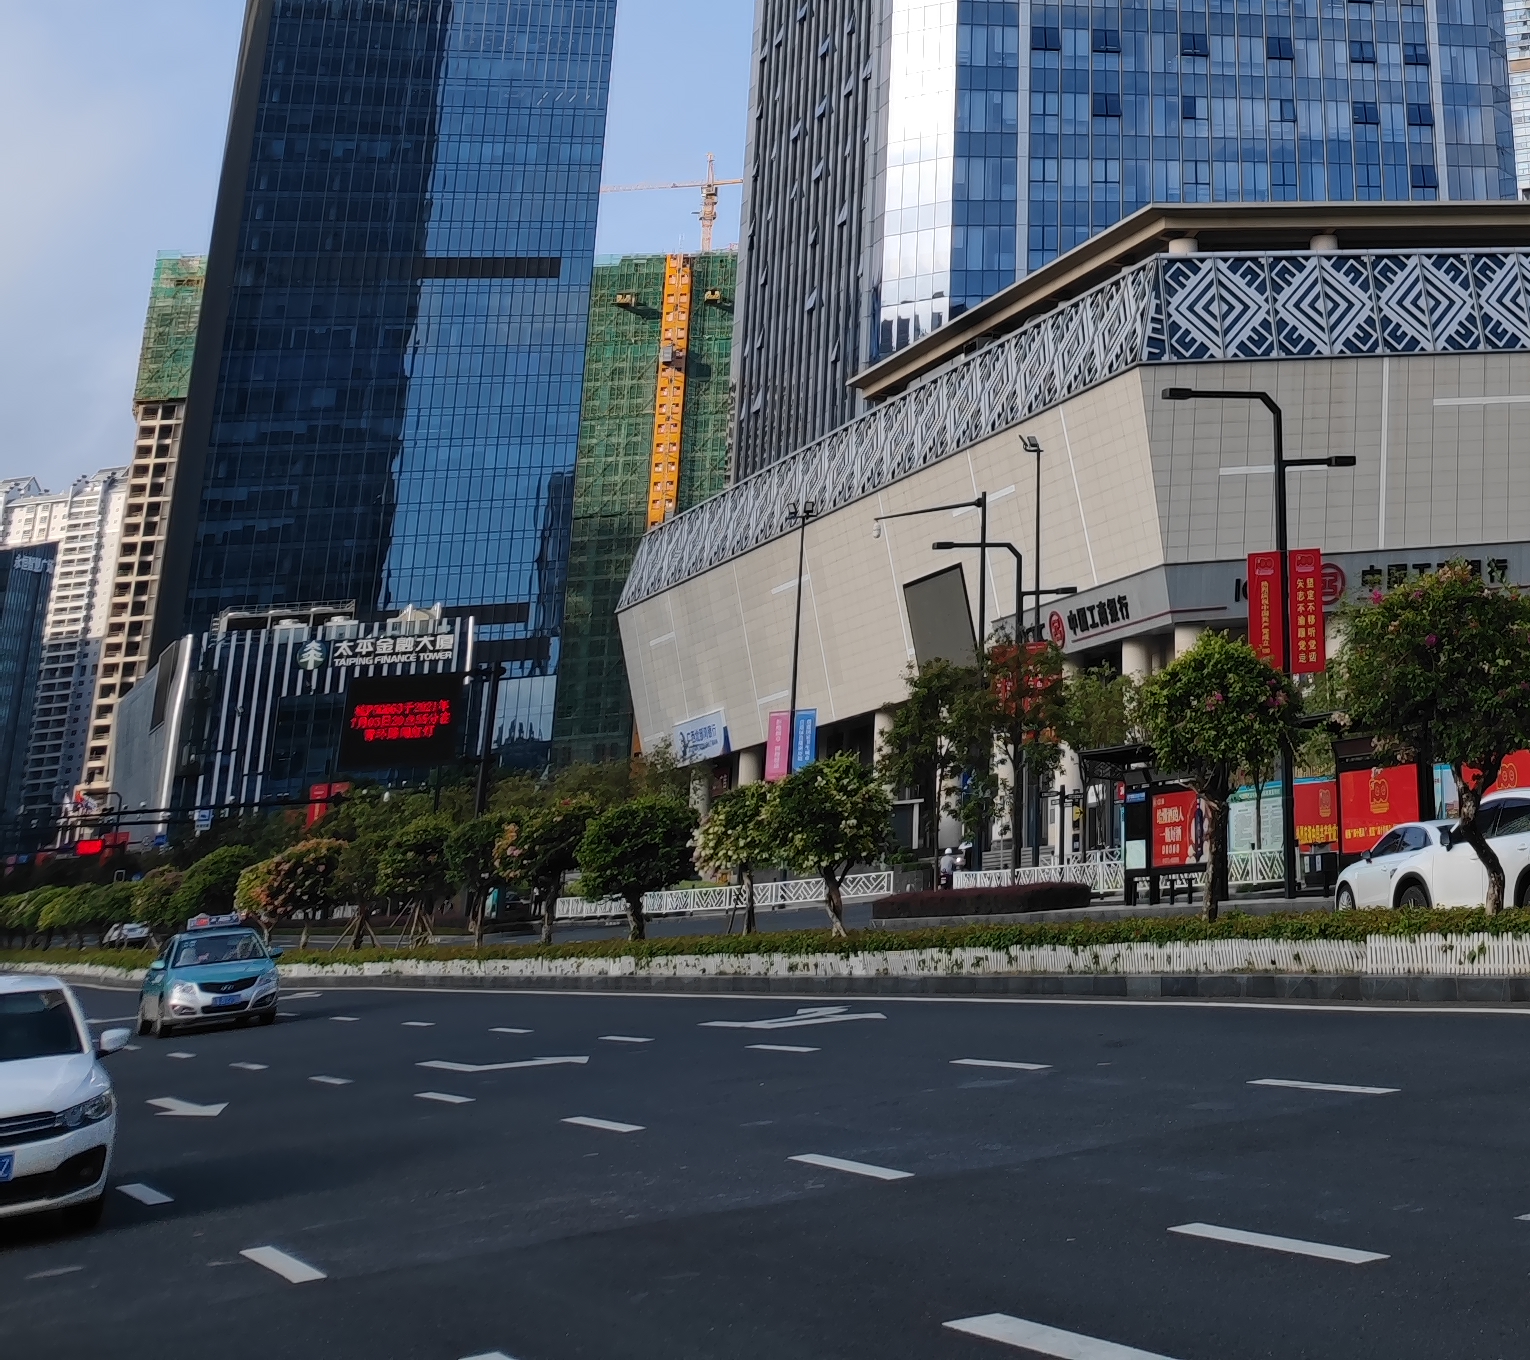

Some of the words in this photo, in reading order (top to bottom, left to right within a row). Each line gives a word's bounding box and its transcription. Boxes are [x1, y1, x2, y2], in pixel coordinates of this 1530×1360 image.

[1067, 594, 1130, 637] 中国工商银行
[333, 633, 455, 657] 太平金融大厦
[333, 657, 373, 667] TAIPING
[374, 653, 416, 664] FINANCE
[419, 651, 452, 661] TOWER
